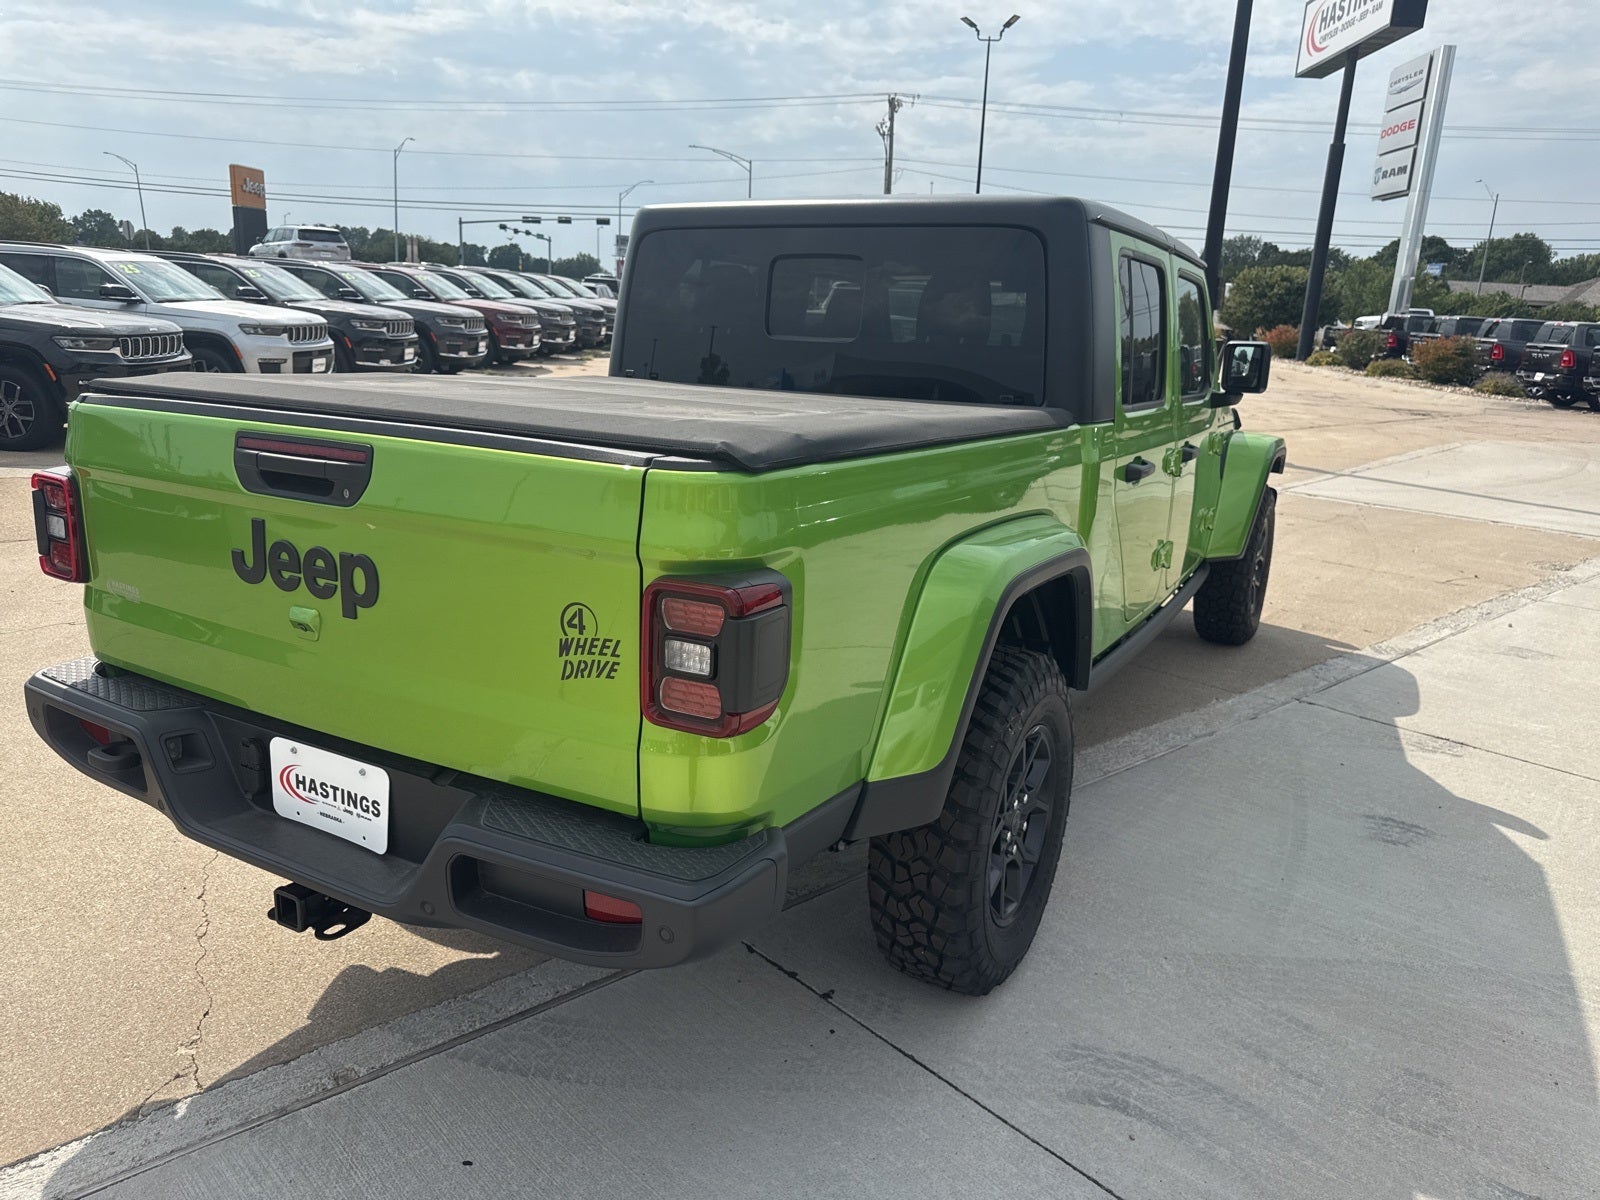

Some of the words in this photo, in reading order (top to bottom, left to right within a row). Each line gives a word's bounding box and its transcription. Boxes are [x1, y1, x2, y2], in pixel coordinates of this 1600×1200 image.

[1389, 68, 1425, 89] CHRYSLER
[1380, 118, 1417, 140] DODGE
[1381, 164, 1409, 181] RAM
[231, 517, 380, 620] Jeep
[566, 607, 586, 636] 4
[558, 636, 621, 658] WHEEL
[560, 659, 621, 681] DRIVE
[294, 772, 382, 818] HASTINGS
